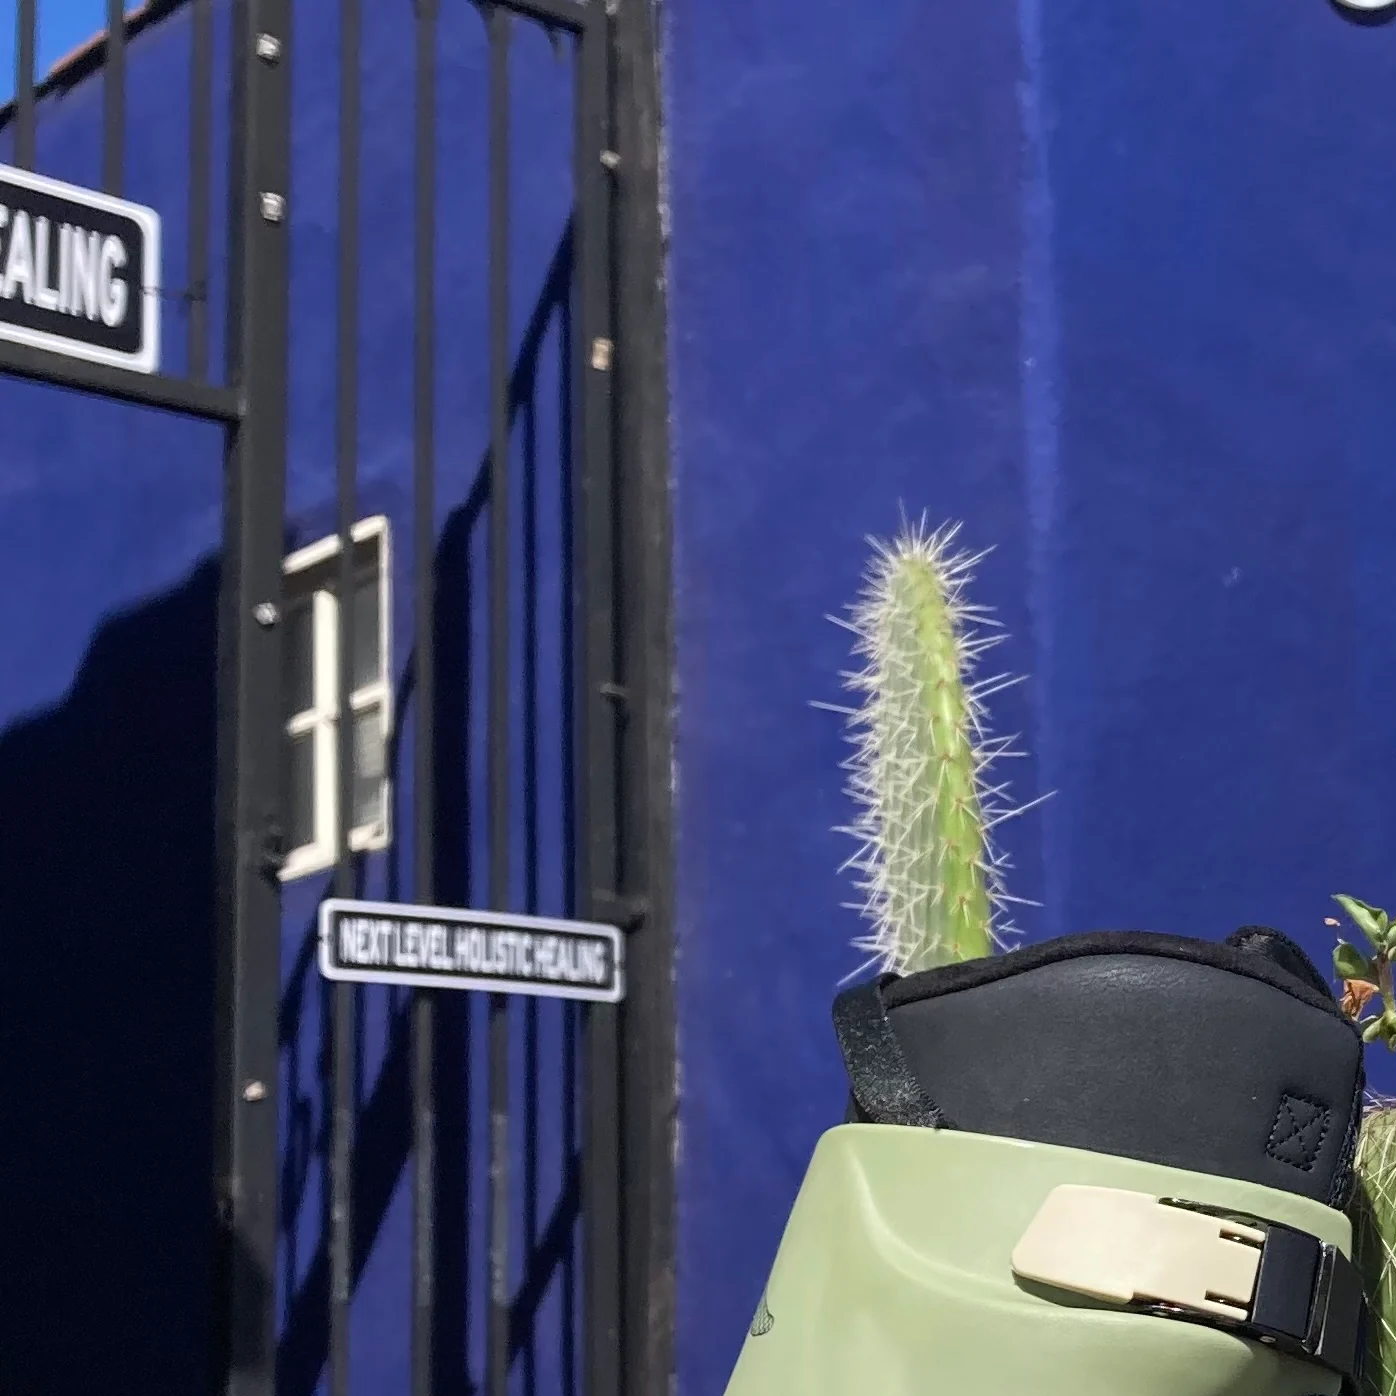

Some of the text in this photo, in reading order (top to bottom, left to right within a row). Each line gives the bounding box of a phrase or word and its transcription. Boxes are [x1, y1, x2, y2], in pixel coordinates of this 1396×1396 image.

[339, 916, 606, 984] NEXT LEVEL HOLISTIC HEALING
